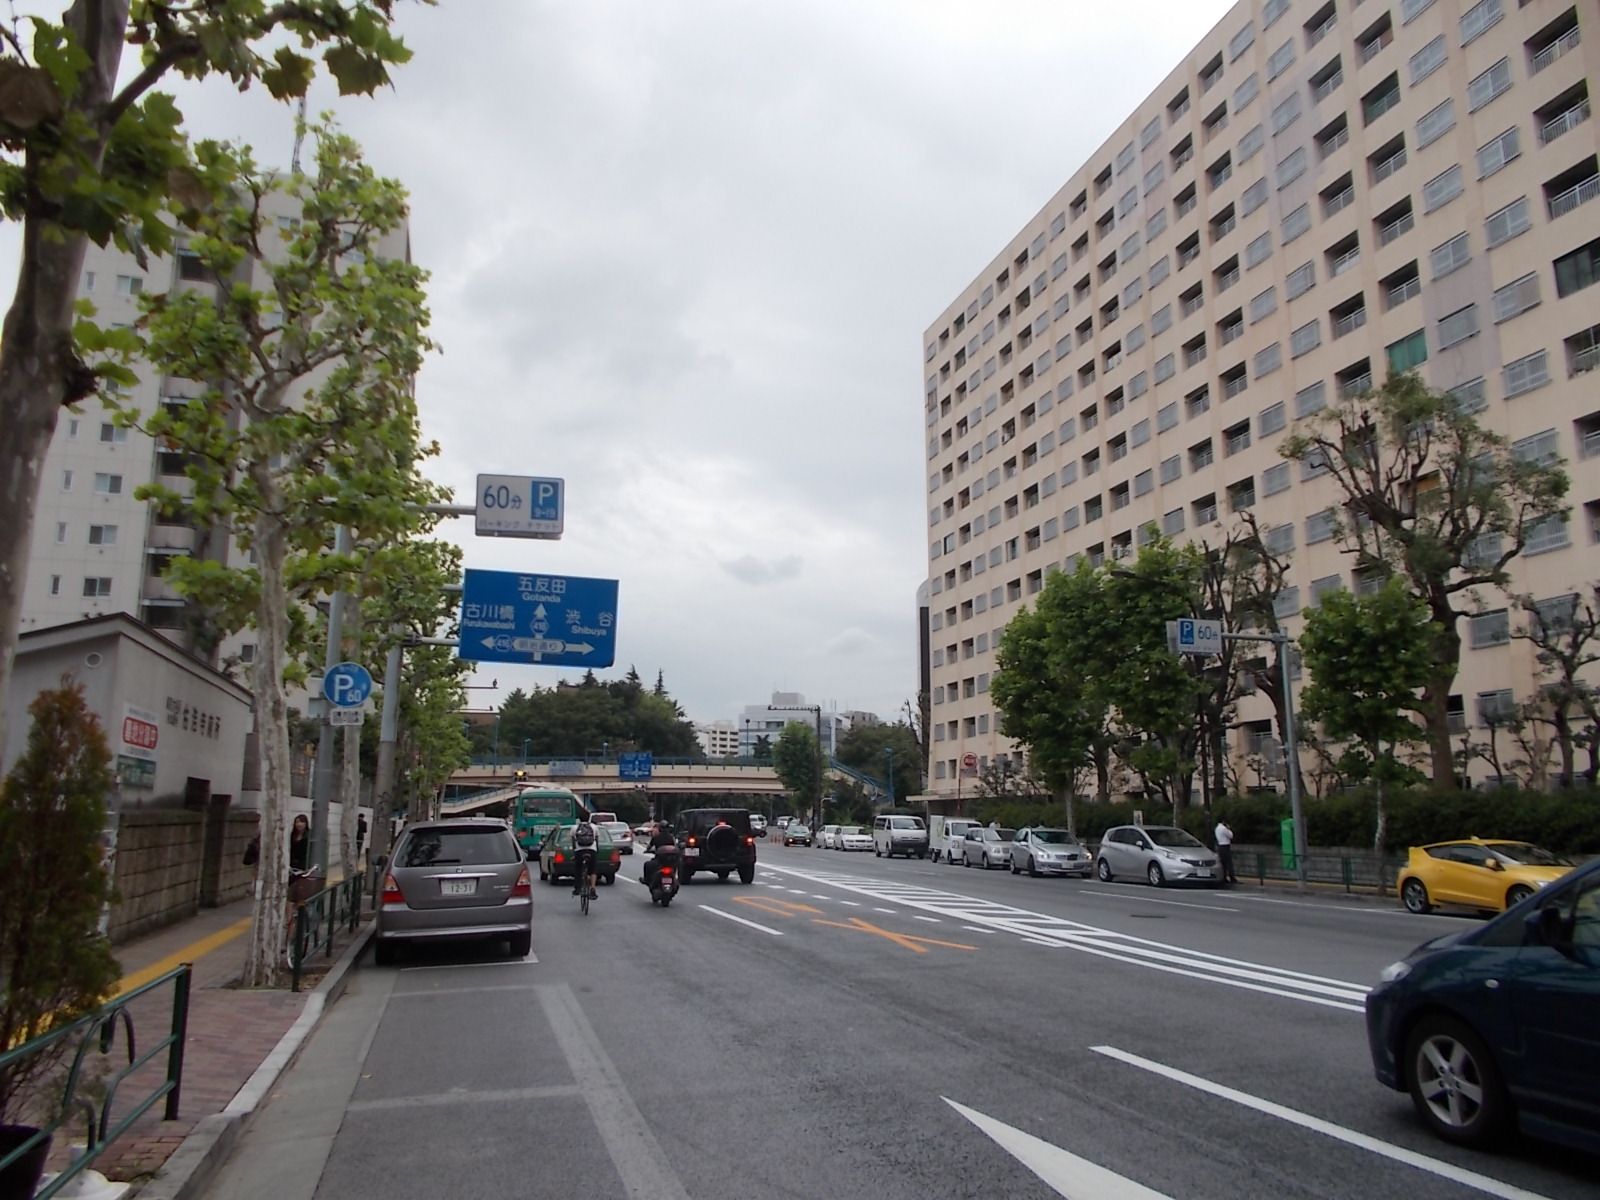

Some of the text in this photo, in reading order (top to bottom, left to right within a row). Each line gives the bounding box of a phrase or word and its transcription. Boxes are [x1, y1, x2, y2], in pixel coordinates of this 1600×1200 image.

[538, 483, 554, 507] P
[518, 576, 567, 594] 五反田
[521, 592, 561, 603] Gotanda
[465, 603, 515, 620] 古川橋
[571, 624, 607, 636] Shibuya
[1183, 622, 1192, 636] P
[334, 674, 354, 702] P
